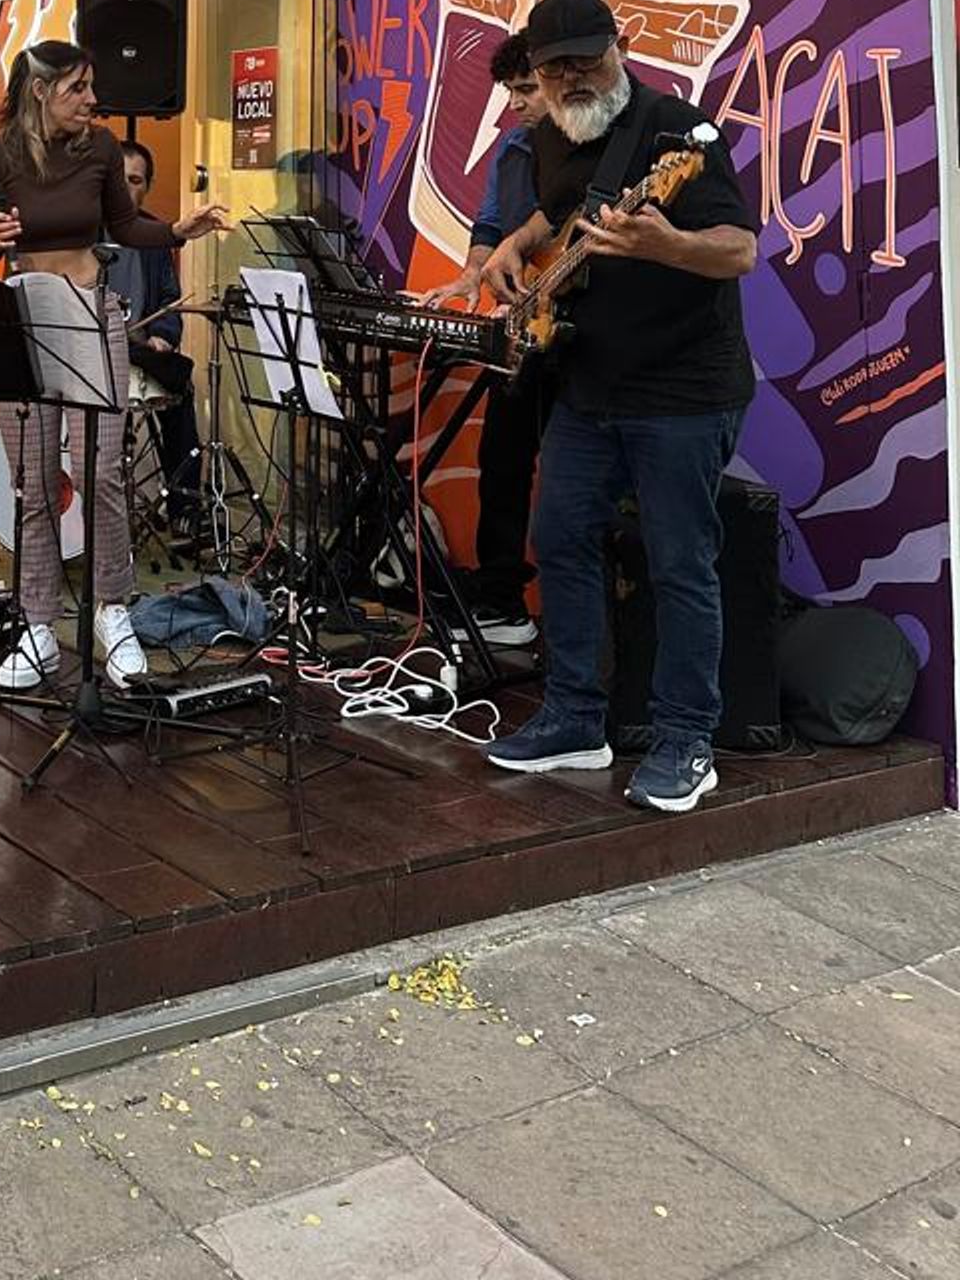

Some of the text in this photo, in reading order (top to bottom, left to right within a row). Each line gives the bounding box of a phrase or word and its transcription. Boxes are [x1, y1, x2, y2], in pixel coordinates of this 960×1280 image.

[237, 80, 274, 99] NUEVO
[237, 101, 273, 119] LOCAL
[714, 24, 907, 269] AÇAI
